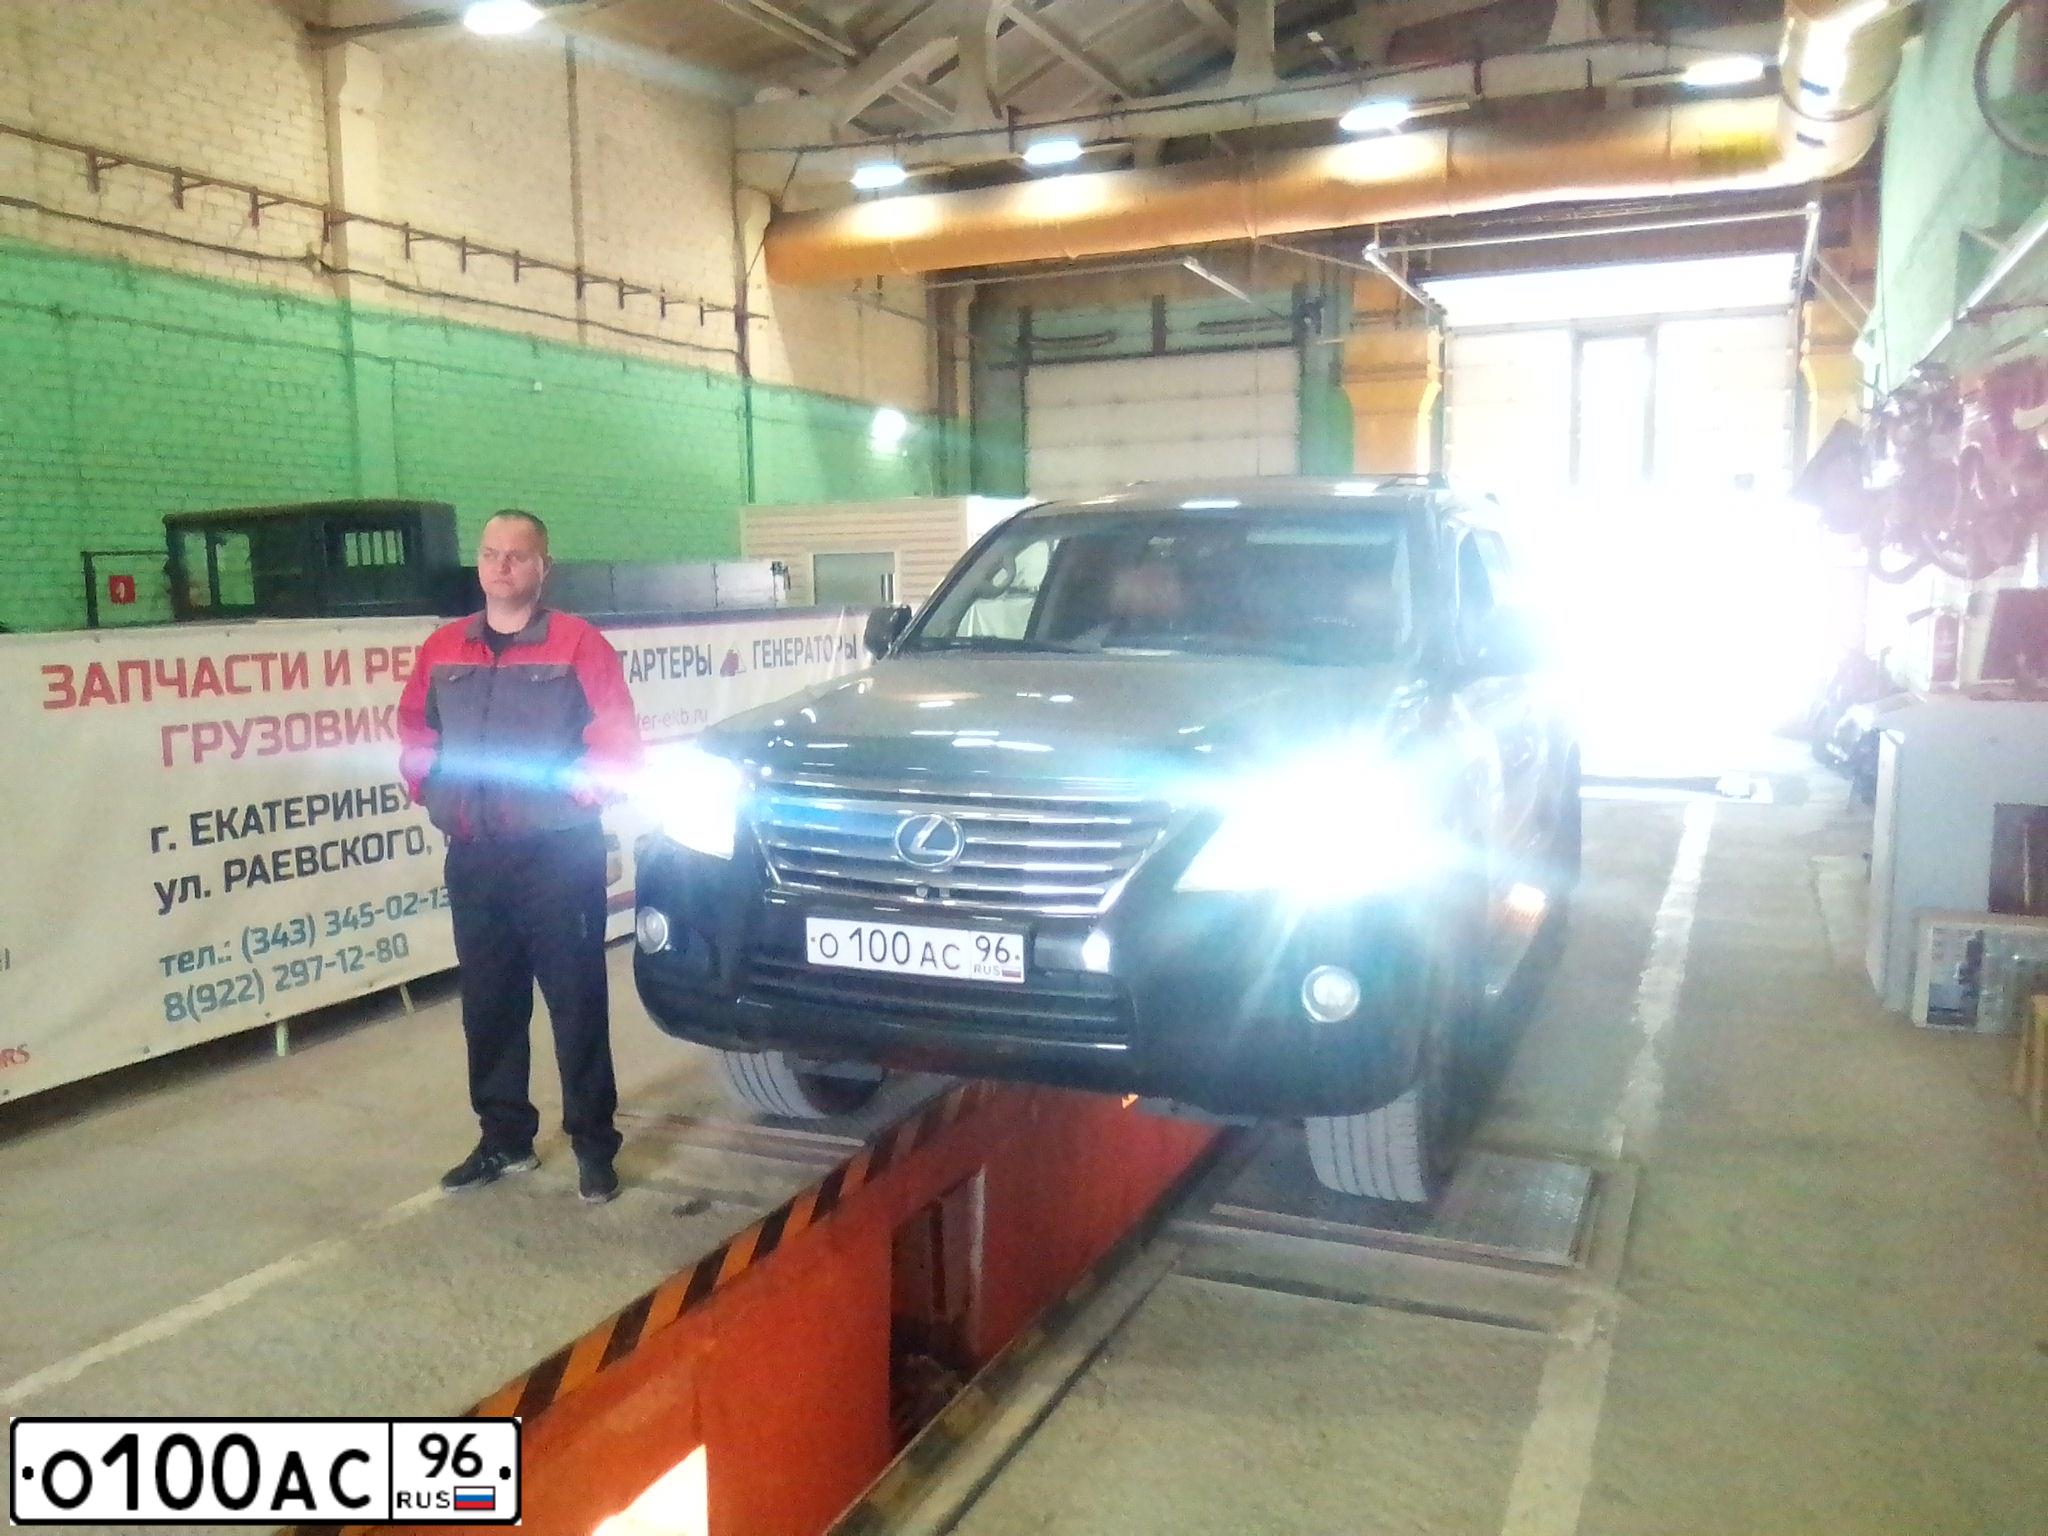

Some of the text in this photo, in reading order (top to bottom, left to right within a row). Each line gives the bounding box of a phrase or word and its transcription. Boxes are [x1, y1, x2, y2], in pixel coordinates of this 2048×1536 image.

[41, 645, 421, 710] ЗАПЧАСТИ И РЕ
[615, 644, 712, 684] ТАРТЕРЫ
[161, 705, 398, 767] ГРУЗОВИК
[150, 825, 176, 854] г.
[153, 825, 432, 915] ул. РАЕВСКОГО,
[159, 942, 232, 978] тел.:
[241, 913, 316, 965] (343)
[973, 963, 1001, 976] RUS
[975, 935, 1010, 963] 96
[163, 933, 410, 1025] 8(922) 297-12-80
